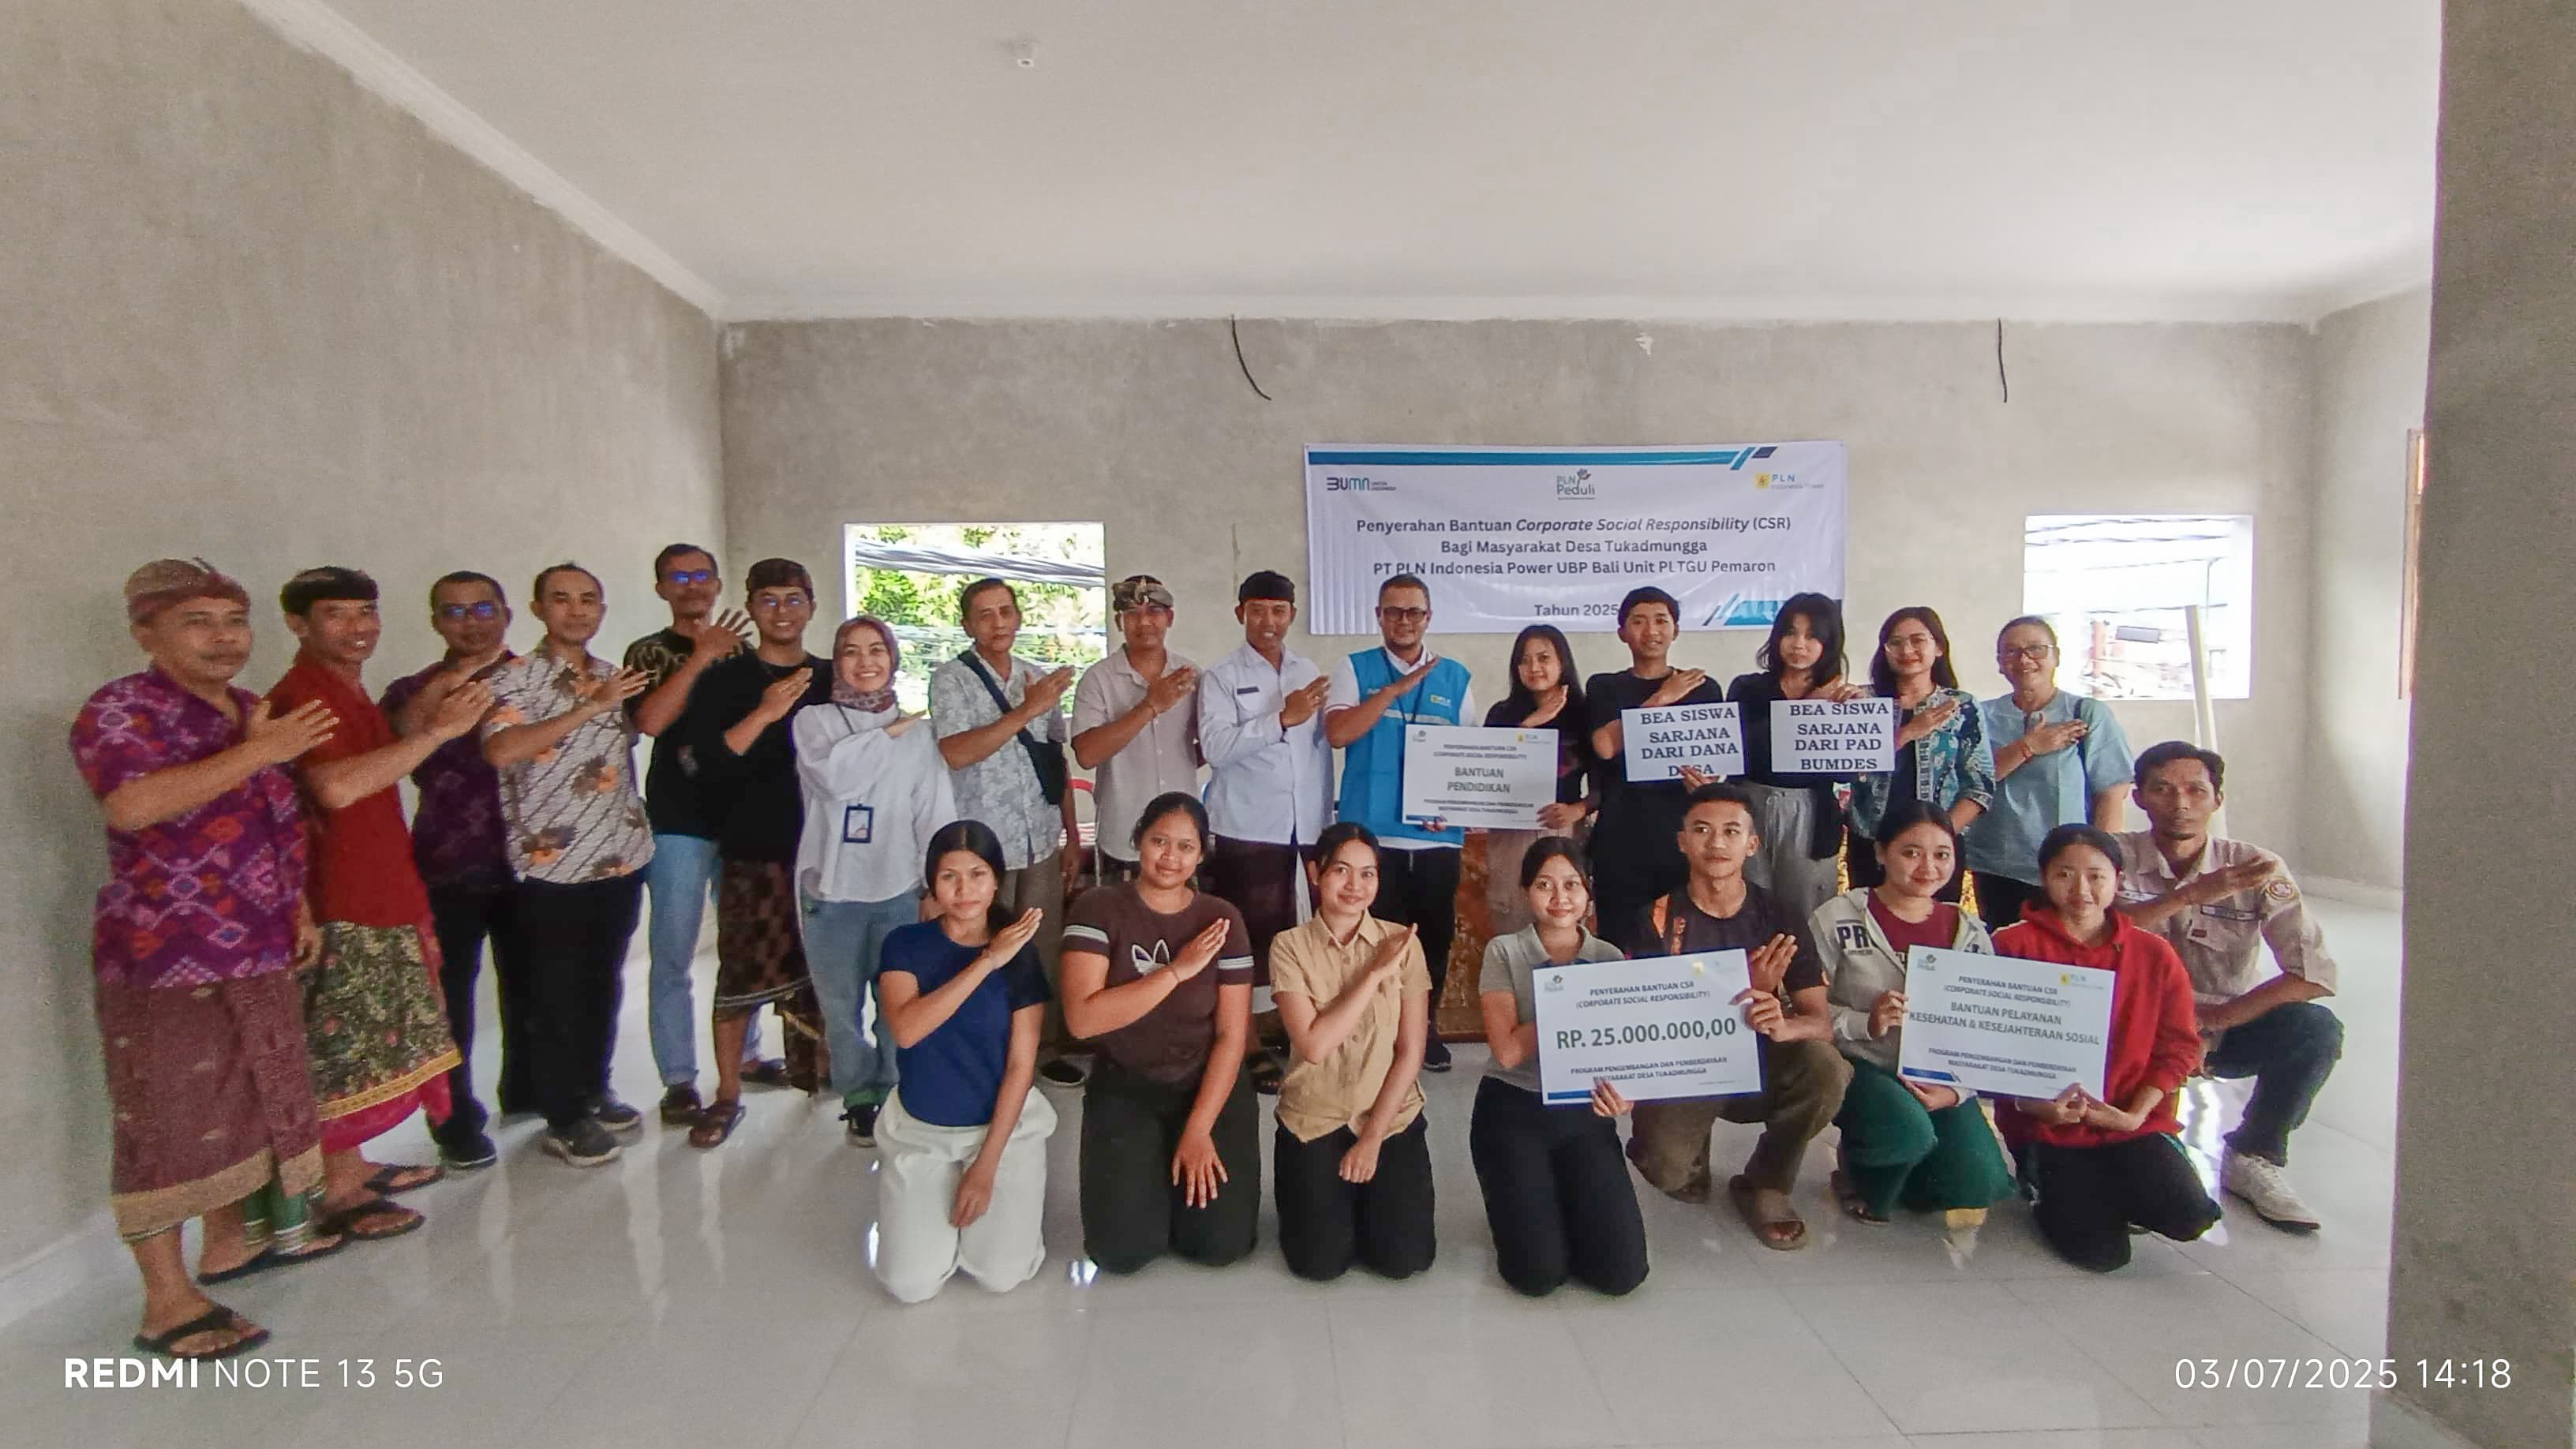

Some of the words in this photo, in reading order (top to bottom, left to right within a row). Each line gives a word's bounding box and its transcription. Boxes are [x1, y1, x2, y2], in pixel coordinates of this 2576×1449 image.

[1556, 475, 1576, 485] PLN
[1772, 474, 1795, 482] PLN
[1556, 483, 1595, 495] Peduli
[1357, 520, 1445, 534] Penyerahan
[1450, 519, 1511, 531] Bantuan
[1516, 519, 1593, 534] Corporate
[1596, 518, 1642, 531] Social
[1646, 517, 1750, 534] Responsibility
[1753, 517, 1791, 530] (CSR)
[1441, 541, 1472, 556] Bagi
[1477, 541, 1561, 556] Masyarakat
[1565, 540, 1601, 552] Desa
[1604, 540, 1707, 554] Tukadmungga
[1374, 563, 1391, 575] PT
[1396, 563, 1425, 575] PLN
[1431, 562, 1503, 575] Indonesia
[1507, 562, 1553, 574] Power
[1556, 561, 1588, 574] UBP
[1593, 560, 1619, 573] Bali
[1623, 560, 1655, 573] Unit
[1659, 561, 1707, 573] PLTGU
[1711, 561, 1775, 573] Pemaron
[1534, 604, 1578, 616] Tahun
[1583, 604, 1618, 616] 2025
[1640, 712, 1676, 724] BEA
[1680, 707, 1736, 721] SISWA
[1789, 704, 1825, 716] BEA
[1831, 702, 1889, 715] SISWA
[1649, 727, 1731, 743] SARJANA
[1797, 723, 1881, 735] SARJANA
[1641, 746, 1685, 759] DARI
[1690, 743, 1739, 757] DANA
[1795, 739, 1839, 751] DARI
[1845, 739, 1881, 751] PAD
[1800, 758, 1878, 770] BUMDES
[1455, 766, 1504, 778] BANTUAN
[1447, 781, 1511, 793] PENDIDIKAN
[1589, 986, 1641, 997] PENYERAHAN
[1642, 983, 1679, 992] BANTUAN
[1950, 1002, 1999, 1017] BANTUAN
[2001, 1009, 2061, 1025] PELAYANAN
[1556, 1030, 1586, 1050] RP.
[1591, 1017, 1736, 1047] 25.000.000,00
[1908, 1012, 1967, 1028] KESEHATAN
[1979, 1021, 2063, 1041] KESEJAHTERAAN
[2065, 1030, 2100, 1046] SOSIAL
